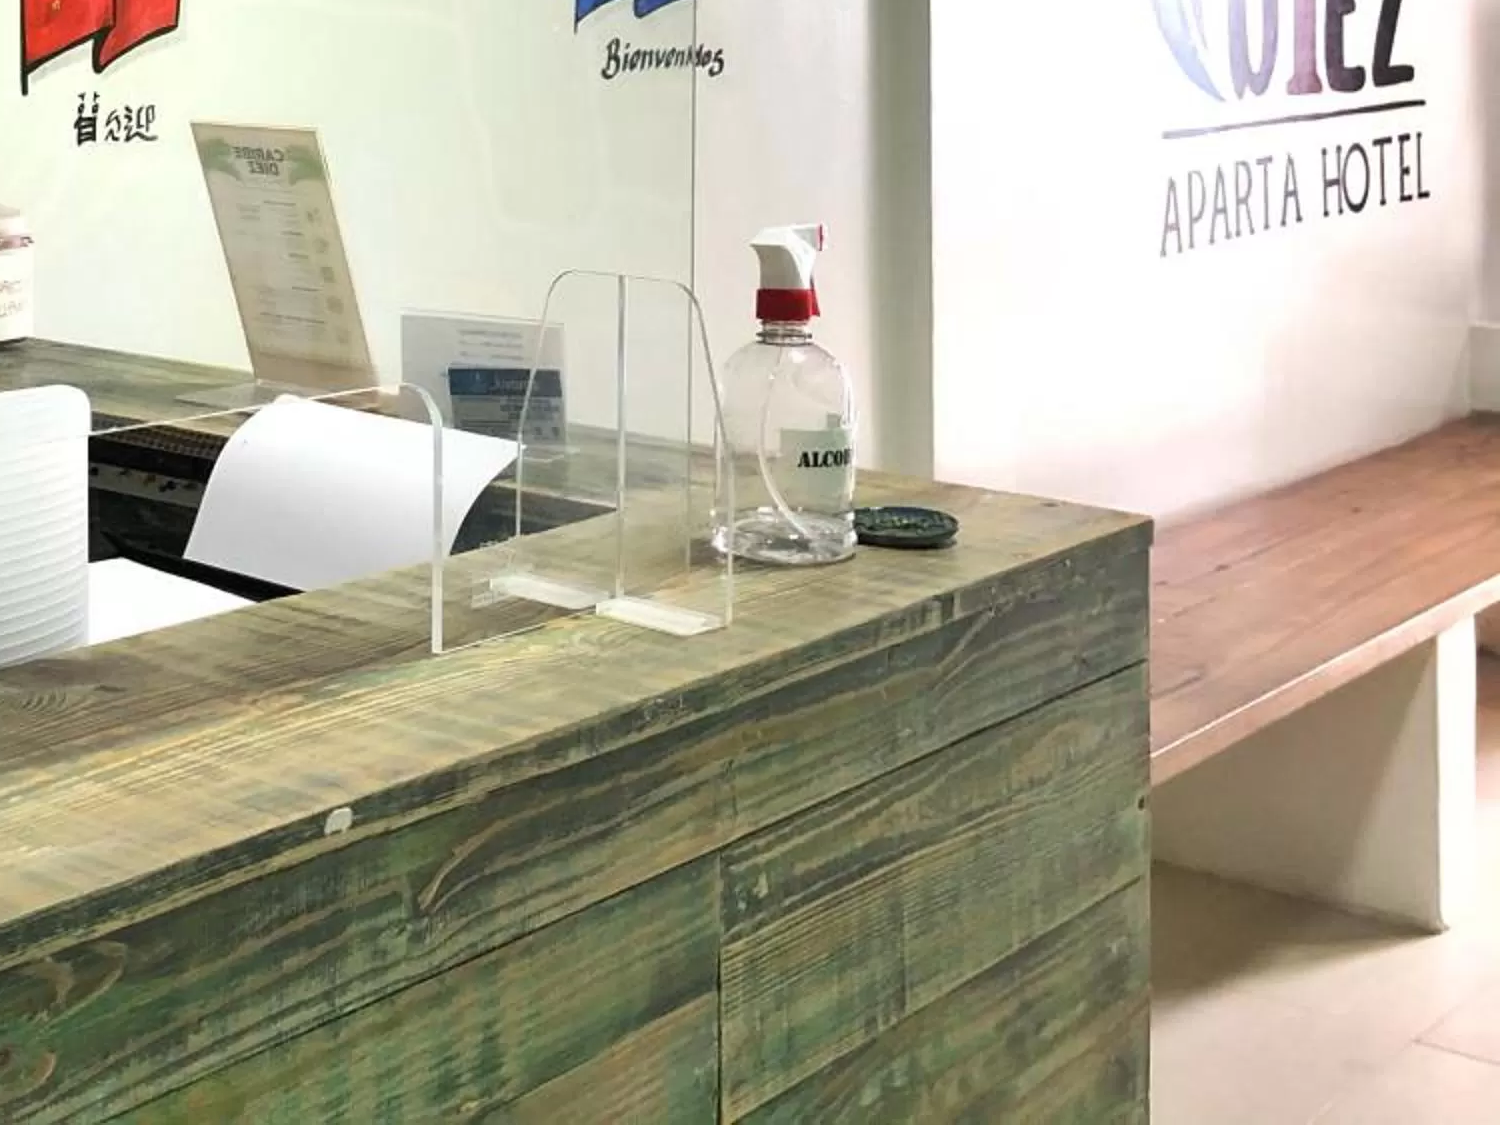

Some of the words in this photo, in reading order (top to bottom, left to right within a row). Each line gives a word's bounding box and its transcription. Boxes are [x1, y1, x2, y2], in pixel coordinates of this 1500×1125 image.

[601, 37, 725, 80] Bienvenidos
[1160, 152, 1303, 258] APARTA
[1321, 131, 1430, 218] HOTEL
